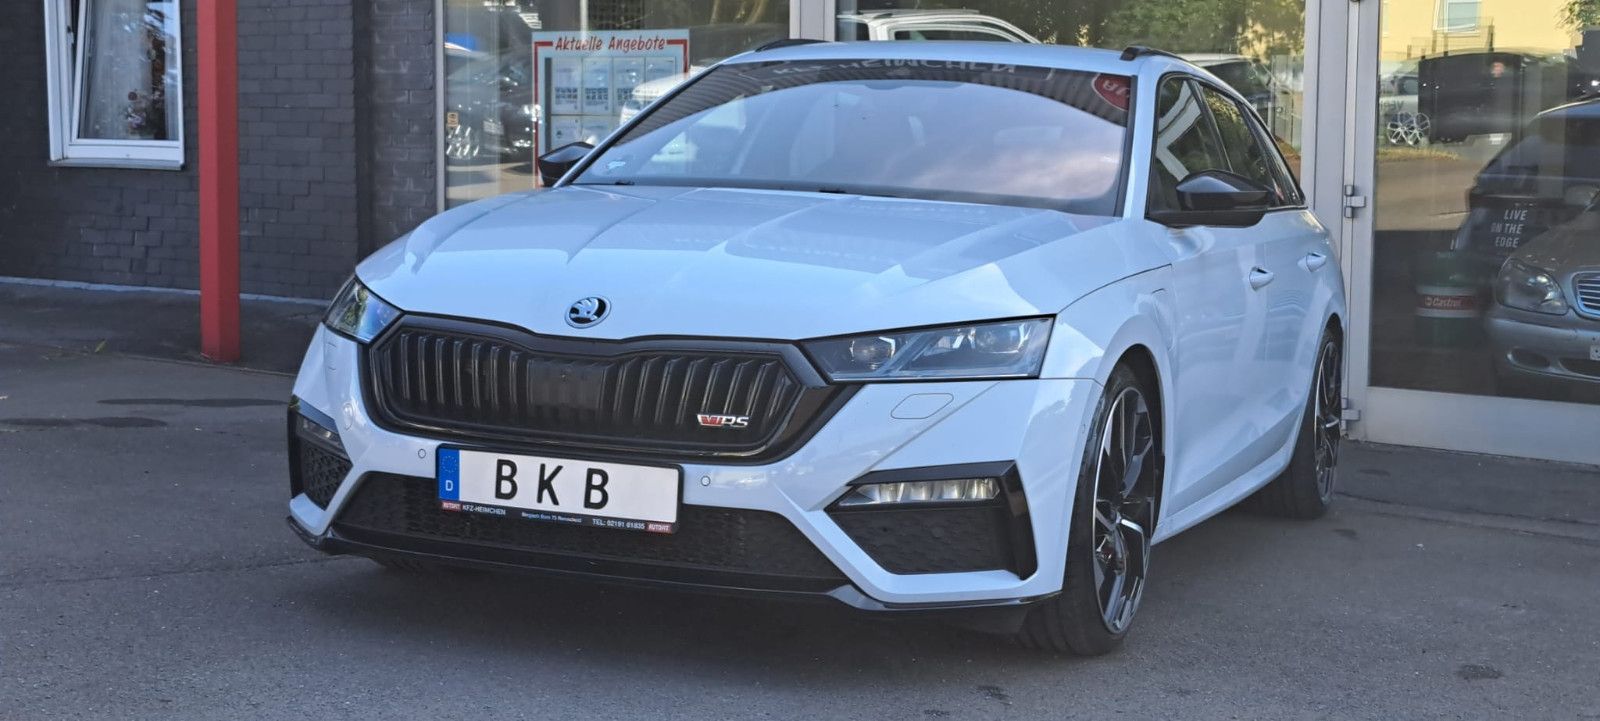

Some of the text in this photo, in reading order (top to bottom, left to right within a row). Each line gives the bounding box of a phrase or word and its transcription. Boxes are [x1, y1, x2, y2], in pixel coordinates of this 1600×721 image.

[554, 35, 666, 53] Aktuelle Angebote
[1504, 209, 1528, 220] LIVE
[1490, 222, 1525, 234] ON THE
[1495, 236, 1520, 248] EDGE
[444, 479, 454, 492] D
[494, 458, 610, 510] B K B
